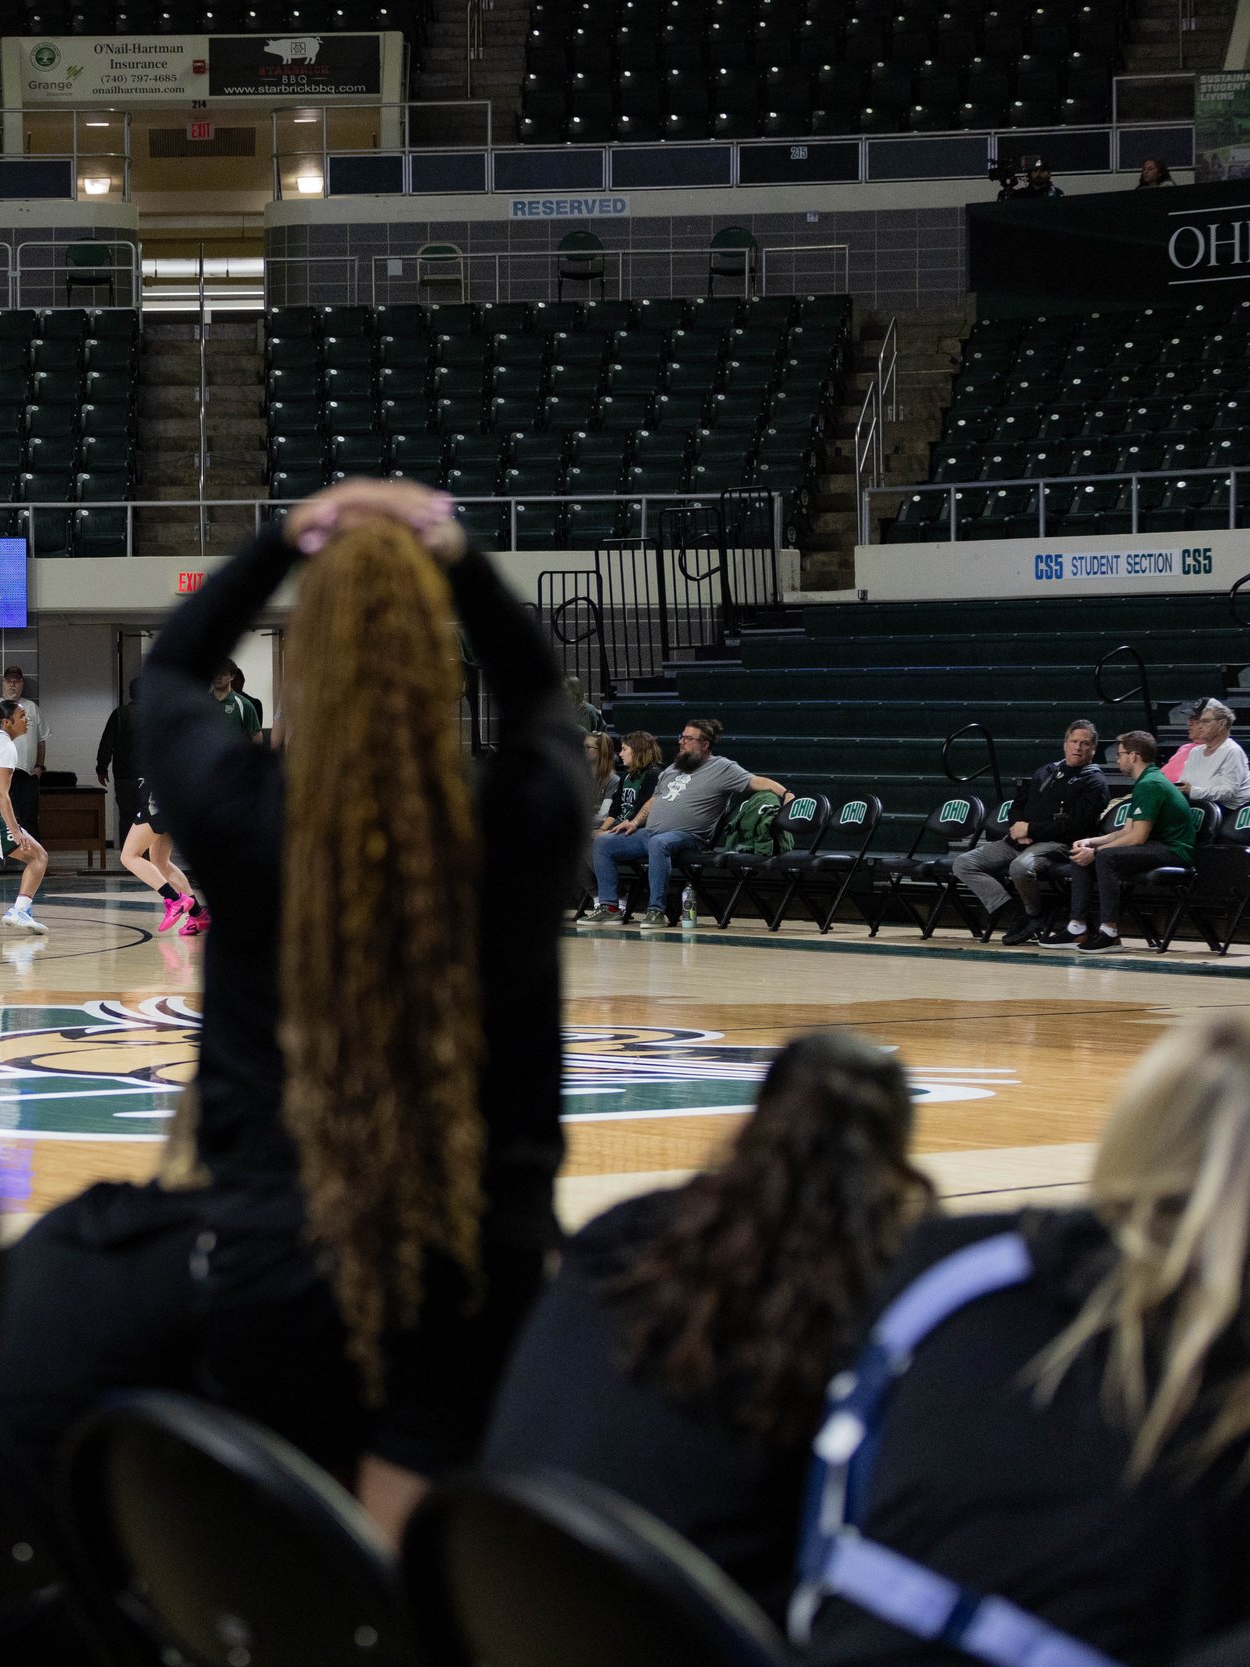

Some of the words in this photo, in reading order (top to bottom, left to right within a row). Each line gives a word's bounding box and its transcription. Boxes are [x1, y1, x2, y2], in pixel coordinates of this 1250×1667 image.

[94, 43, 184, 55] O'Nail-Hartman
[110, 59, 168, 69] Insurance
[101, 74, 127, 84] (740)
[131, 74, 177, 83] 797-4685
[282, 75, 307, 83] BBQ
[28, 80, 73, 91] Grange
[92, 85, 185, 95] onailhartman.com
[223, 84, 366, 94] www.starbrickbbq.com
[192, 101, 206, 109] 214
[191, 122, 211, 138] EXIT
[790, 146, 808, 159] 215
[512, 198, 626, 217] RESERVED
[1035, 554, 1063, 580] CS5
[1071, 555, 1120, 576] STUDENT
[1126, 553, 1173, 575] SECTION
[1182, 548, 1212, 575] CS5
[179, 573, 204, 592] EXIT
[789, 798, 817, 821] OHIO
[839, 801, 868, 824] OHIO
[940, 799, 970, 823] OHIO
